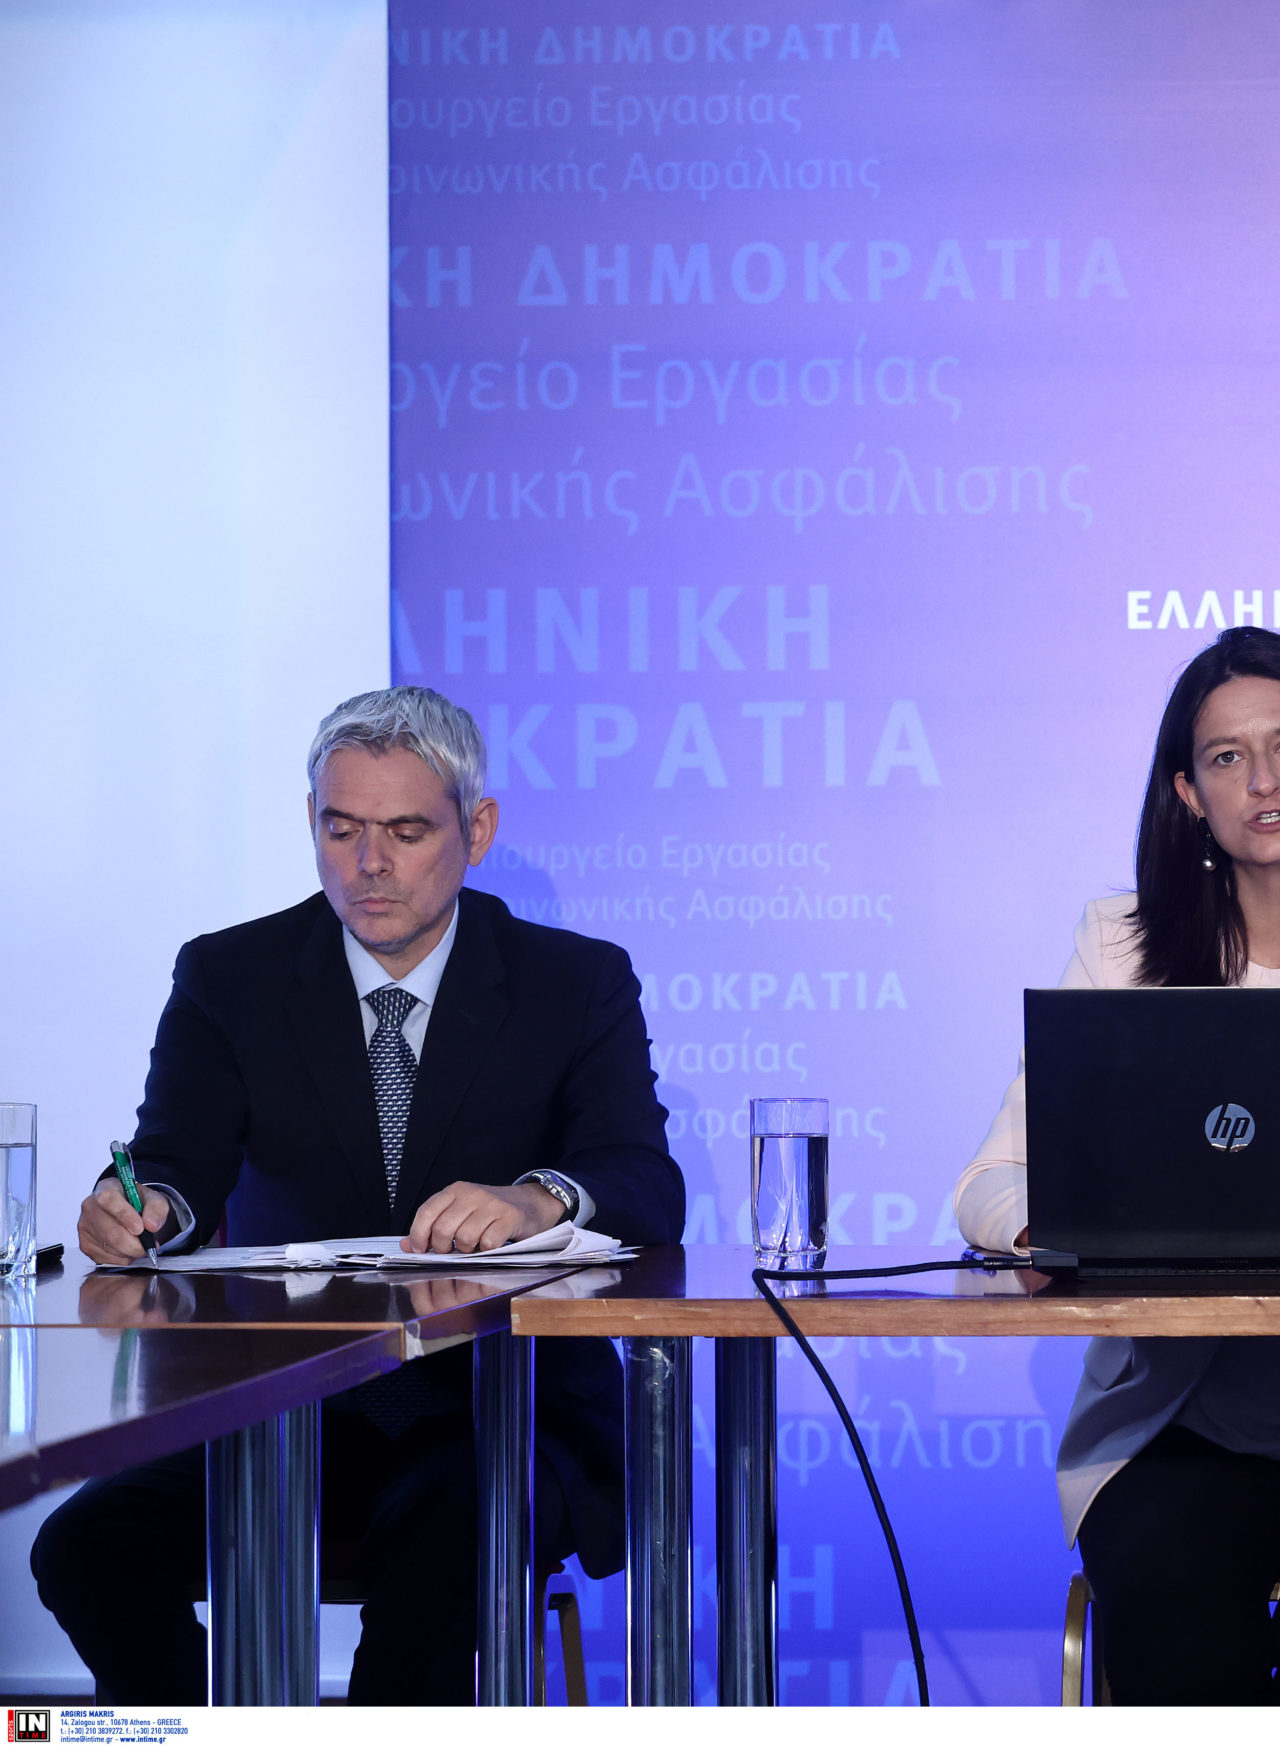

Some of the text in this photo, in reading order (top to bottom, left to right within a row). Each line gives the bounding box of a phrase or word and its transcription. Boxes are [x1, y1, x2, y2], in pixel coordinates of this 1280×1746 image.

[533, 23, 902, 65] ΔΗΜΟΚΡΑΤΙΑ
[589, 80, 802, 136] Εργασίας
[621, 145, 882, 201] Ασφάλισης
[516, 237, 1129, 308] ΔΗΜΟΚΡΑΤΙΑ
[611, 333, 962, 426] Εργασίας
[663, 442, 1094, 533] Ασφάλισης
[661, 830, 830, 875] Εργασίας
[687, 885, 893, 927] Ασφάλισης
